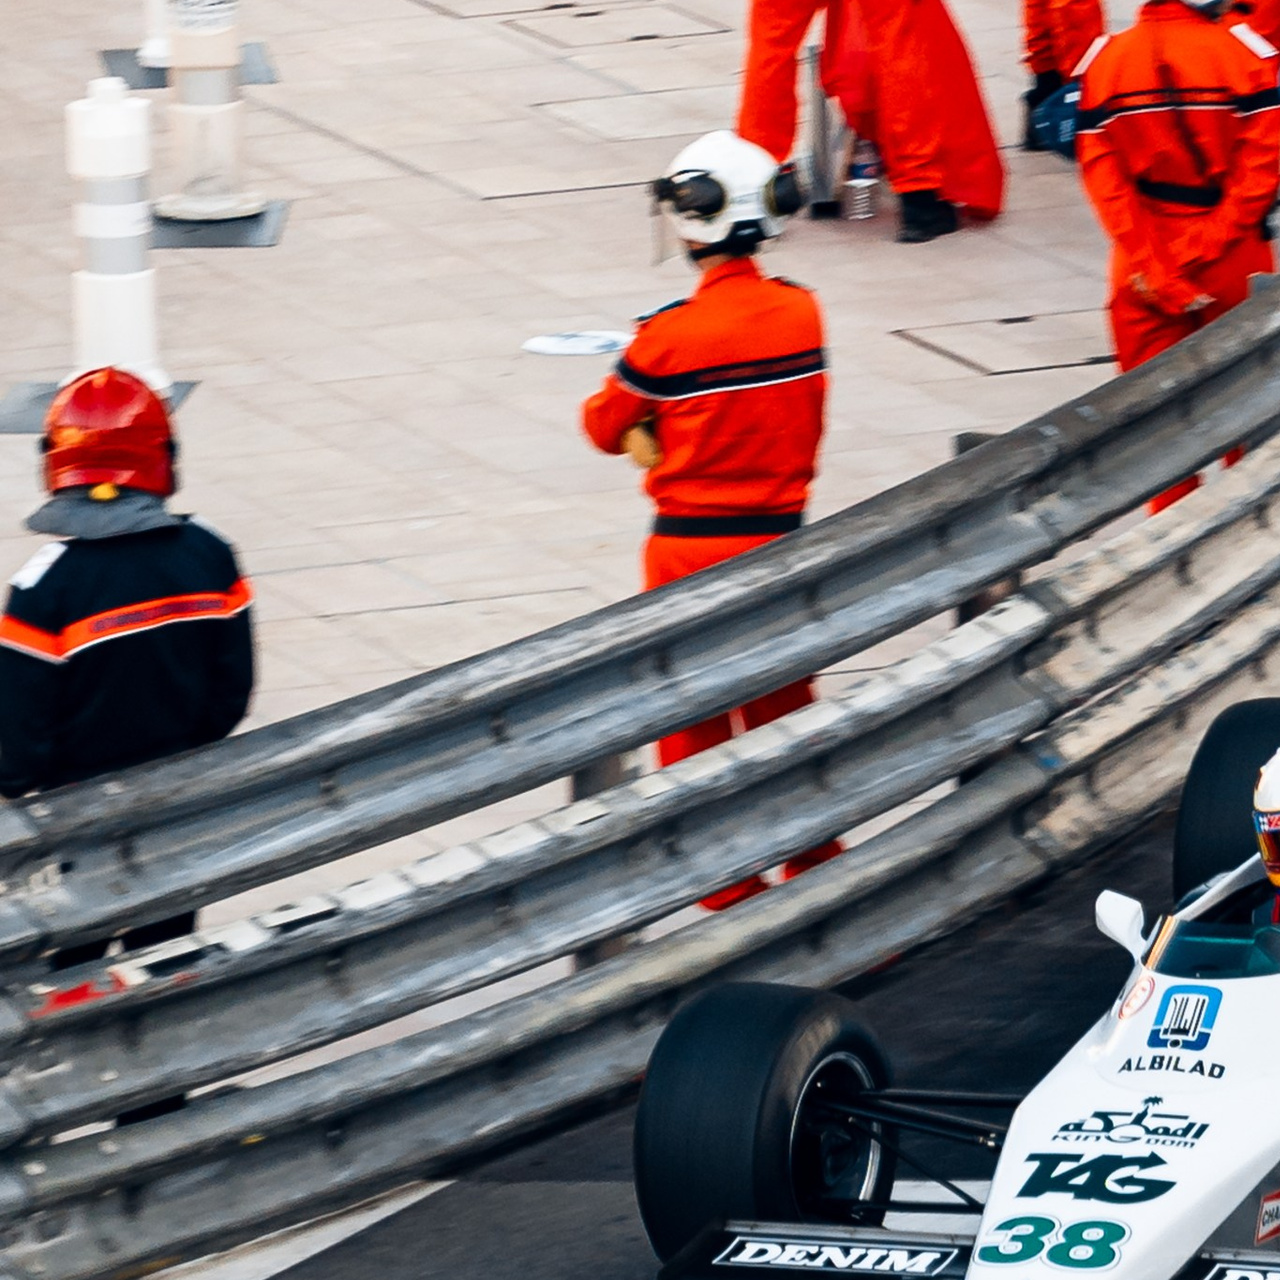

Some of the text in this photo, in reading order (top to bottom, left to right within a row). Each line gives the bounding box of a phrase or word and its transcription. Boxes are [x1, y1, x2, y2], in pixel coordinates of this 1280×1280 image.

[1118, 1055, 1226, 1079] ALBILAD
[1015, 1151, 1177, 1204] TAG
[730, 1242, 941, 1273] DENIM
[978, 1216, 1127, 1268] 38
